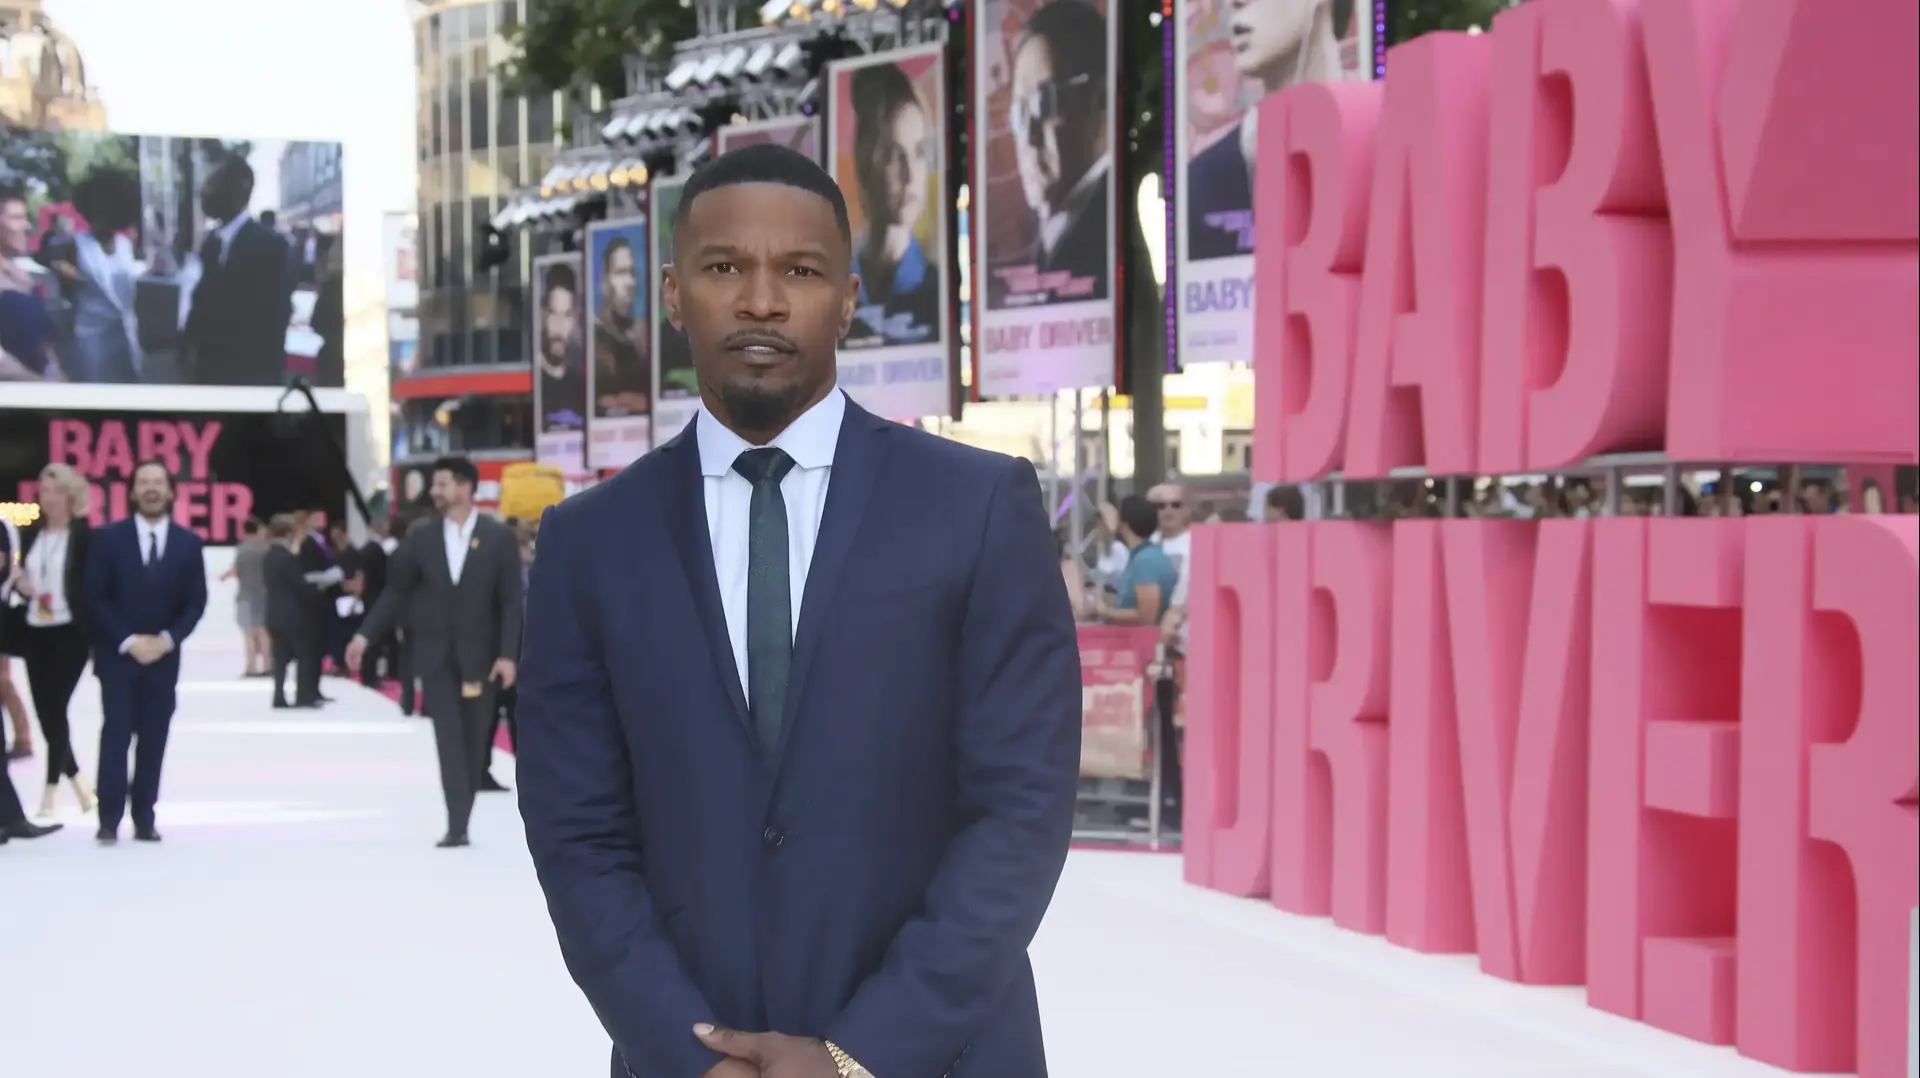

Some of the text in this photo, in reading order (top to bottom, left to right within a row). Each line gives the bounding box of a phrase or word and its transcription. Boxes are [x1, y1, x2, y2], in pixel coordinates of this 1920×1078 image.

[1186, 277, 1254, 315] BABY
[1252, 0, 1918, 482] BABY
[49, 419, 222, 479] BABY
[1183, 514, 1919, 1078] DRIVER
